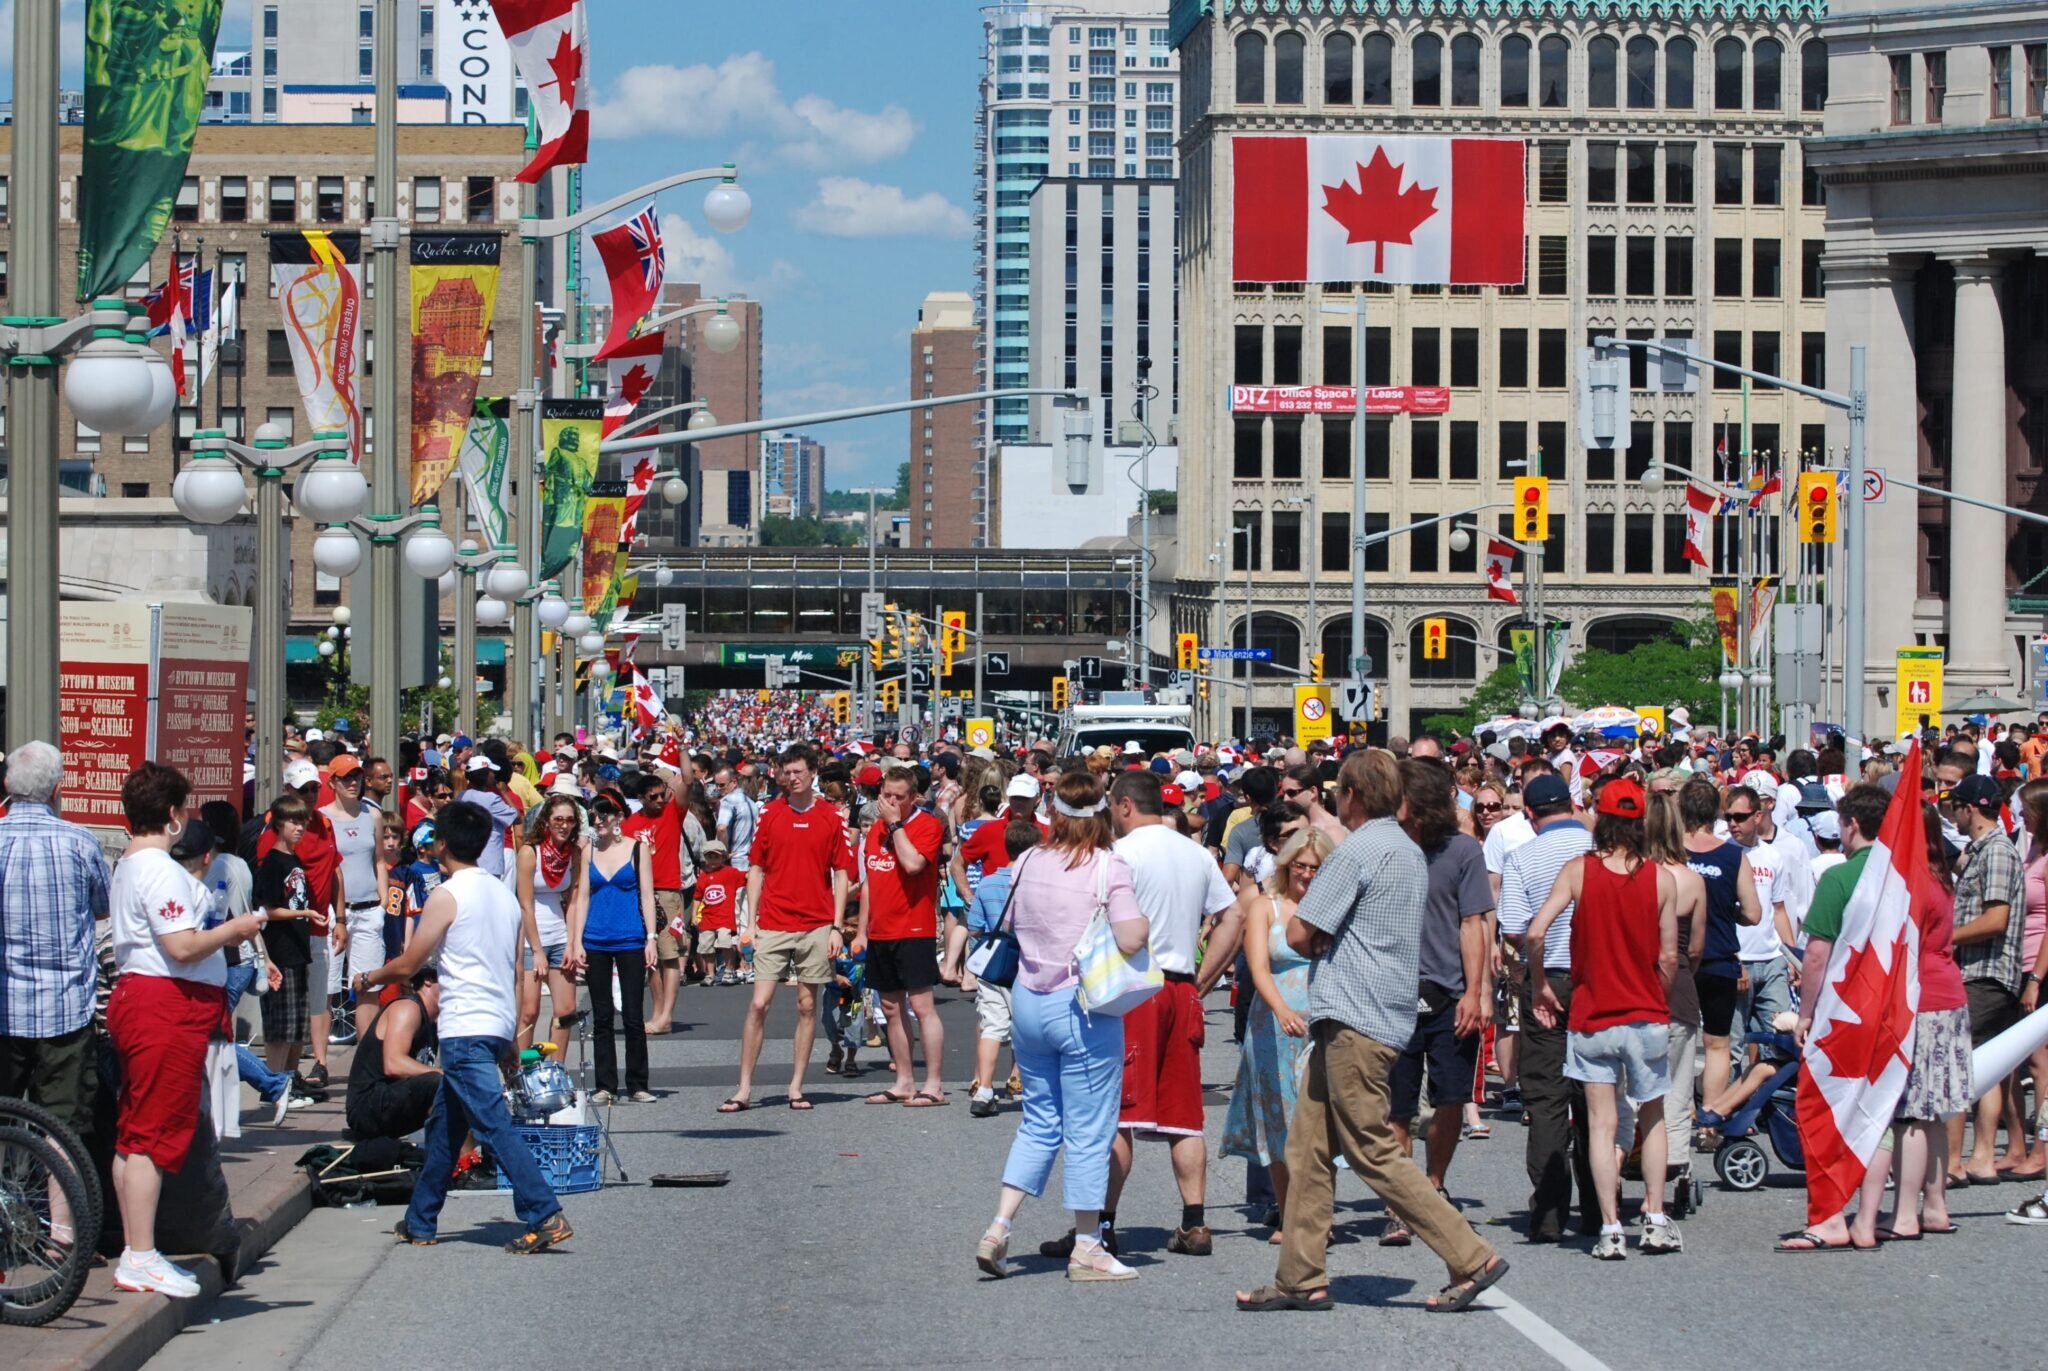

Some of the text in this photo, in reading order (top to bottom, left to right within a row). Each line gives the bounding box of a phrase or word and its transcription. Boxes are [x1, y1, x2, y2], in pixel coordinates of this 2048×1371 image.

[417, 237, 497, 259] Québec 400
[1234, 387, 1269, 404] DTZ
[1314, 388, 1348, 400] Space
[1351, 389, 1369, 398] Fr
[1372, 389, 1404, 399] Lease
[577, 408, 600, 417] 400
[1314, 401, 1333, 410] 1215
[96, 675, 135, 691] MUSEUM
[175, 670, 205, 686] BYTOWN
[206, 671, 236, 687] MUSEUM
[61, 698, 76, 712] RUE
[92, 698, 125, 715] COURAGE
[174, 694, 190, 709] TRUE
[202, 694, 229, 711] COURAGE
[91, 716, 133, 738] SCANDAL!
[166, 712, 192, 730] PASSION
[200, 712, 234, 732] SCANDAL!
[97, 752, 131, 772] COURAGE,
[203, 748, 232, 766] COURAGE,
[193, 767, 233, 786] SCANDALE!
[60, 796, 89, 813] MUSÉE
[867, 854, 896, 872] Carlsberg
